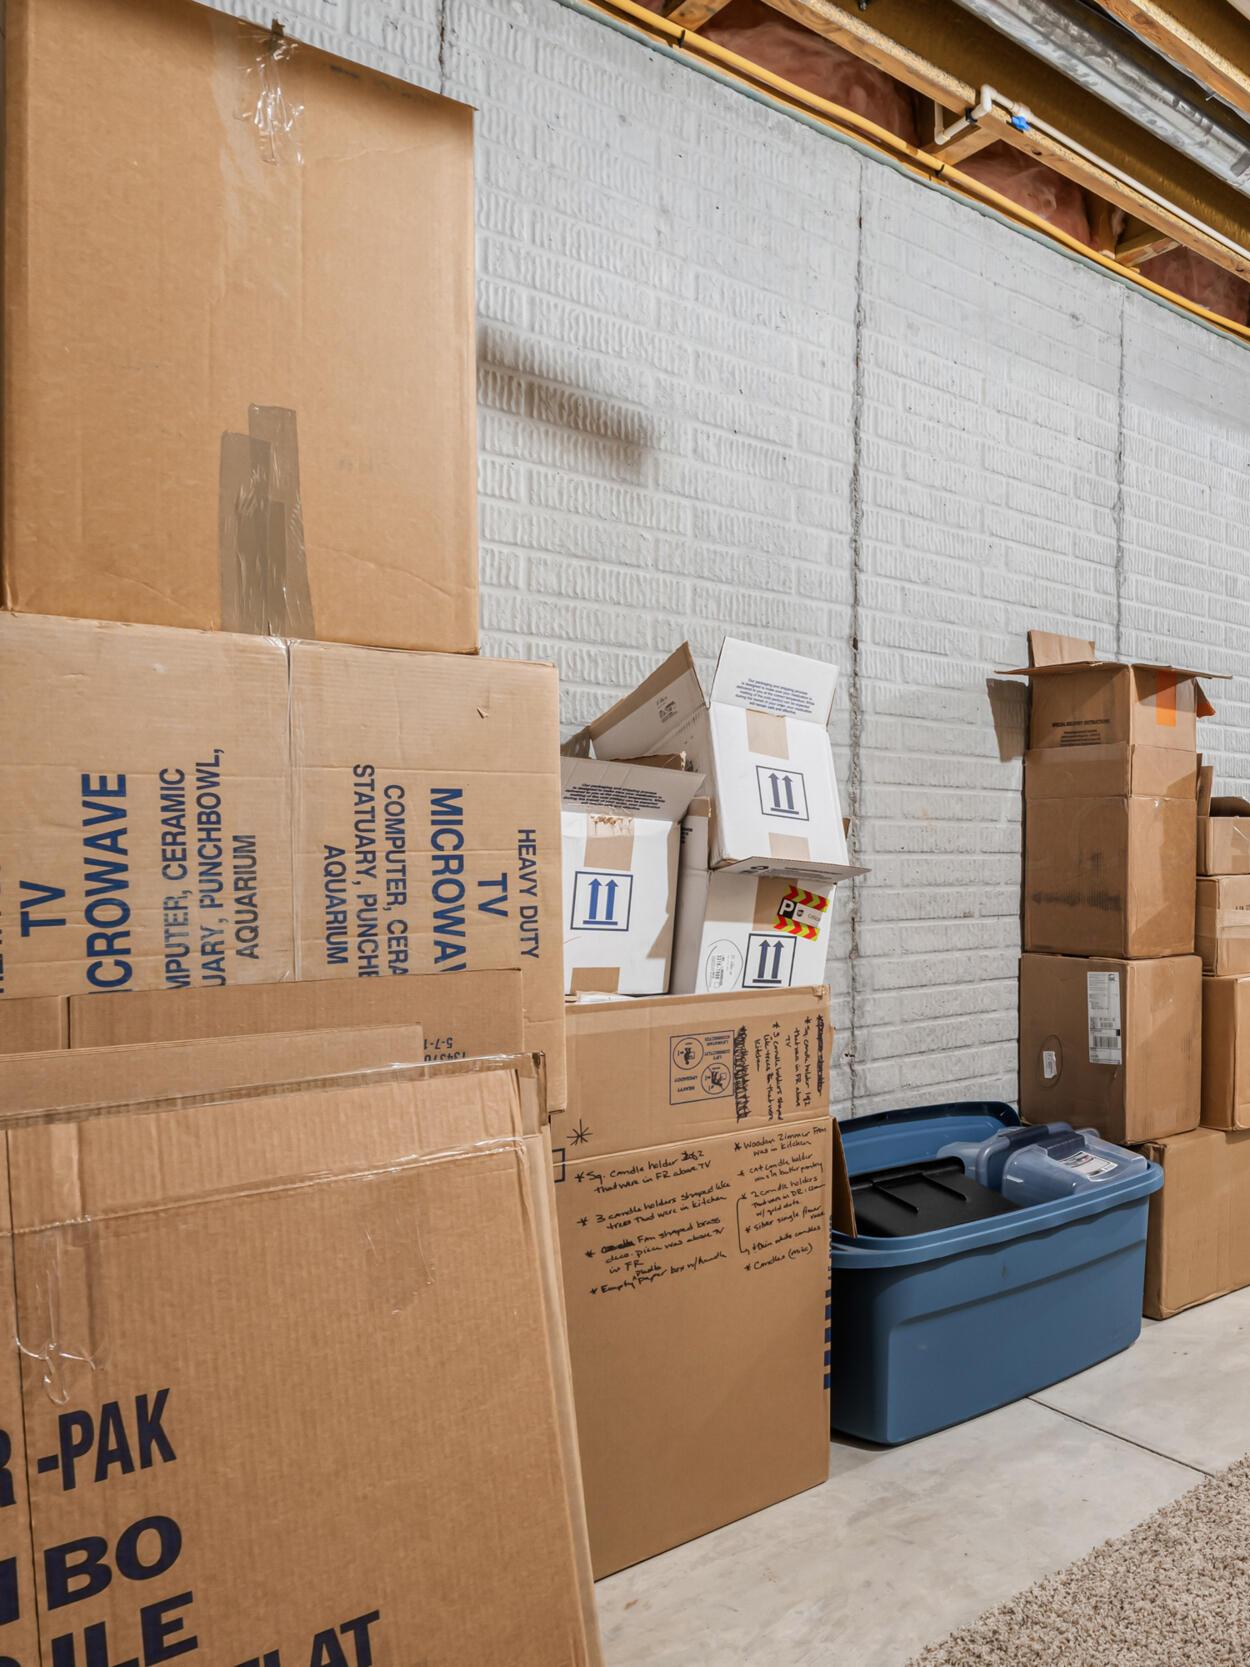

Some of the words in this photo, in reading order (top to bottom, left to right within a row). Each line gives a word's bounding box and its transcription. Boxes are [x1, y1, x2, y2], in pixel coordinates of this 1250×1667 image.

[159, 768, 188, 880] CERAMIC
[196, 748, 224, 909] PUNCHBOWL,
[382, 784, 408, 911] COMPUTER,
[518, 829, 538, 897] HEAVY
[19, 880, 66, 937] TV
[232, 834, 260, 959] AQUARIUM
[323, 844, 349, 965] AQUARIUM
[477, 872, 509, 917] TV
[519, 905, 539, 959] DUTY
[699, 1160, 712, 1170] TV
